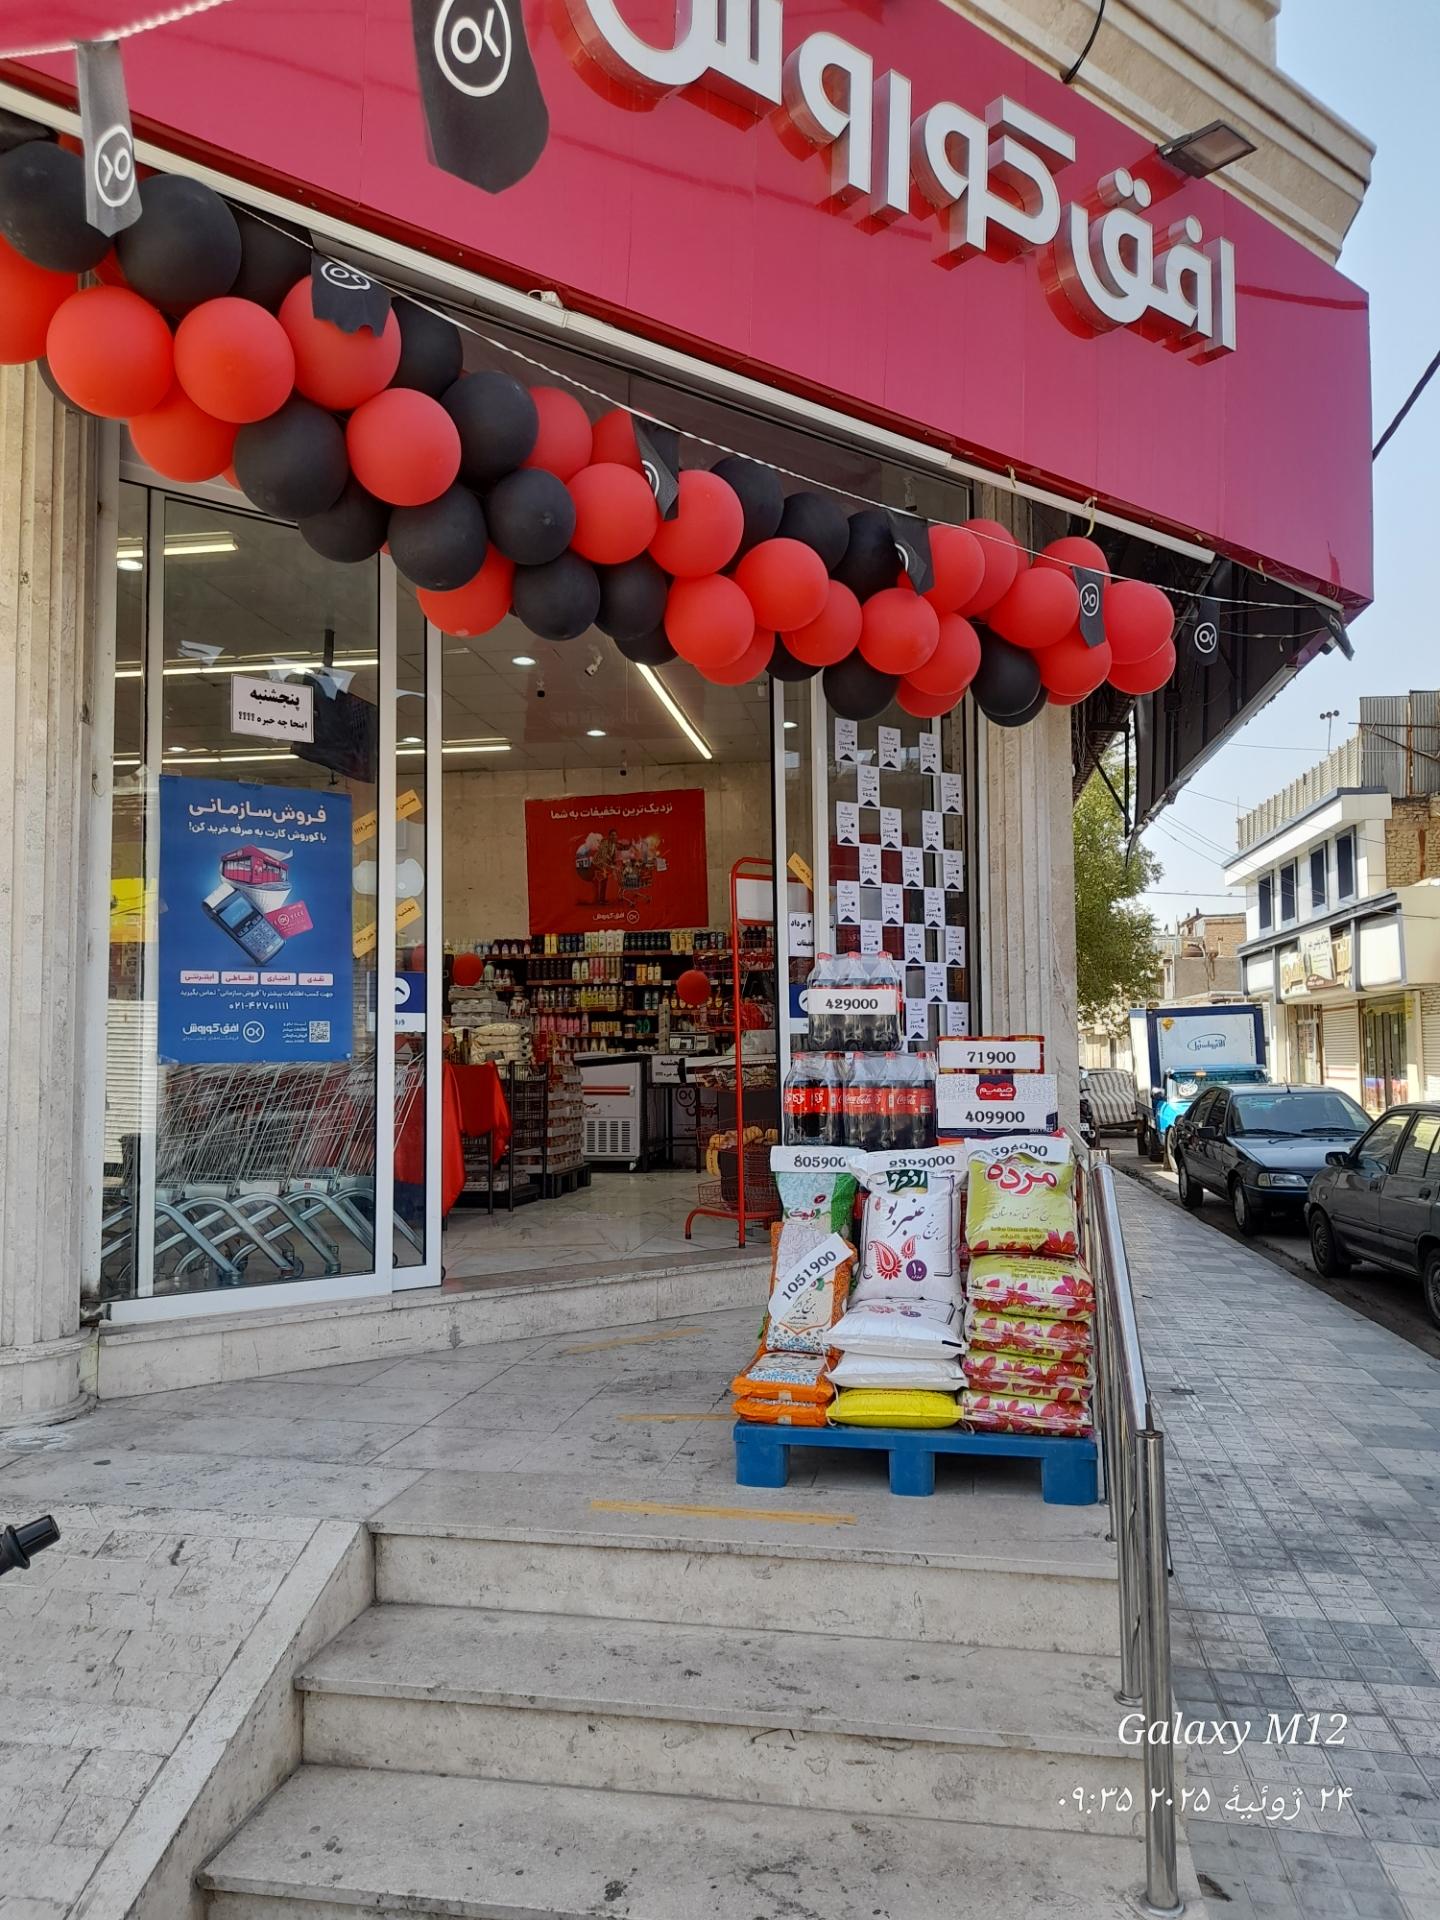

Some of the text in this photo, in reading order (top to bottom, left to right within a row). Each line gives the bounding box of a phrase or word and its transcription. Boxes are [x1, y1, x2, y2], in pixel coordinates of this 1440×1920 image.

[450, 8, 501, 64] OK
[1052, 167, 1237, 358] افق
[250, 689, 300, 711] پنجشنبه
[188, 797, 272, 820] سازمانی
[272, 803, 327, 826] فروش
[550, 809, 568, 820] شما
[265, 828, 287, 839] کارت
[287, 830, 319, 843] کوروش
[825, 998, 878, 1011] 429000
[182, 1022, 239, 1035] افق کوروش
[967, 1051, 1016, 1065] 71900
[965, 1110, 1025, 1124] 409900
[793, 1154, 847, 1168] 805900
[781, 1251, 837, 1300] 1051900
